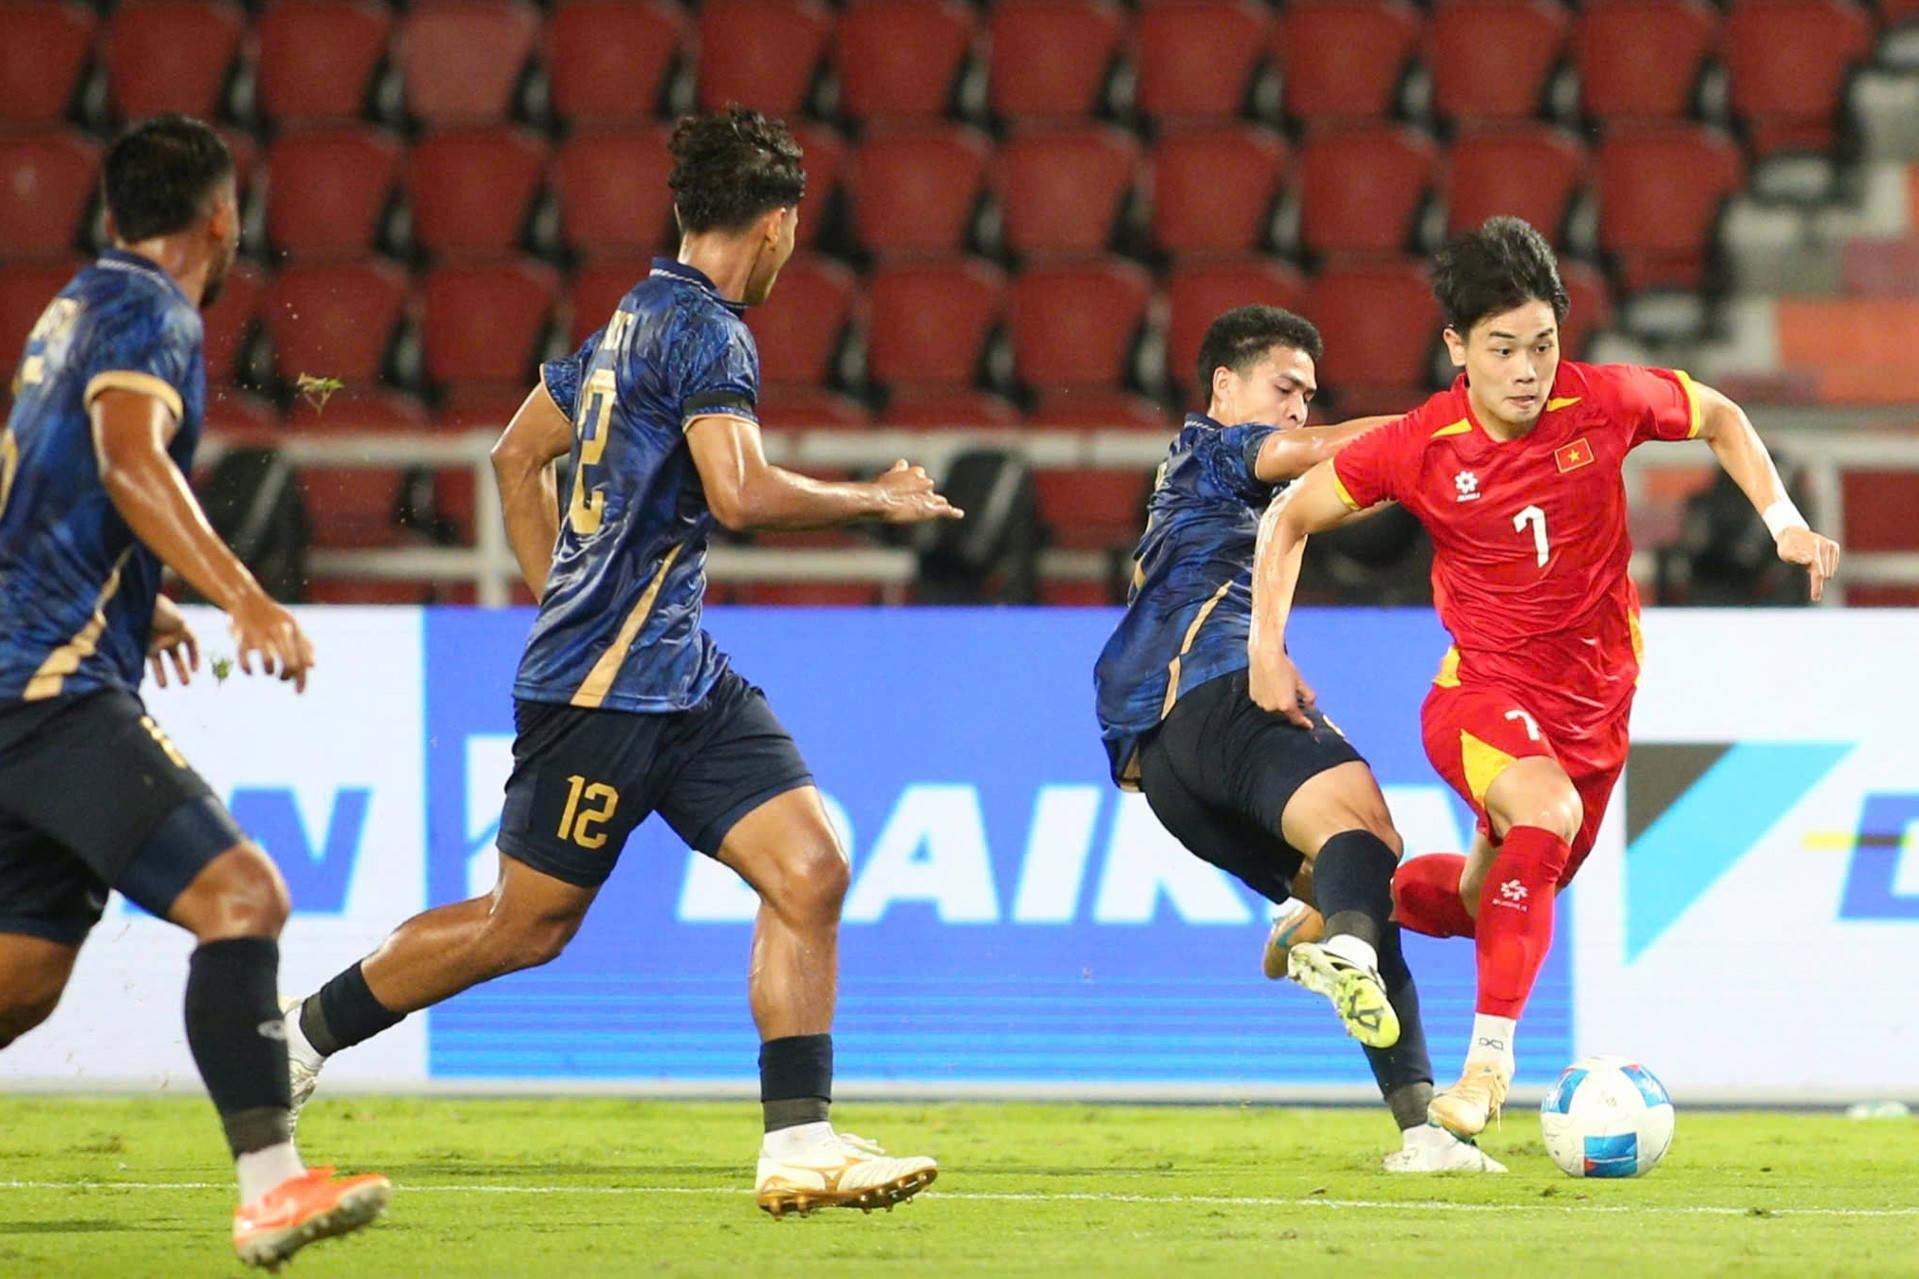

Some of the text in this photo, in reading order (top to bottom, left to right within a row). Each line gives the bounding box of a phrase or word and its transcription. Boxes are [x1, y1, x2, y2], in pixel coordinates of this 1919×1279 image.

[1512, 504, 1550, 569] 7
[1504, 708, 1541, 741] 7
[557, 774, 619, 849] 12
[674, 783, 1478, 924] AIK
